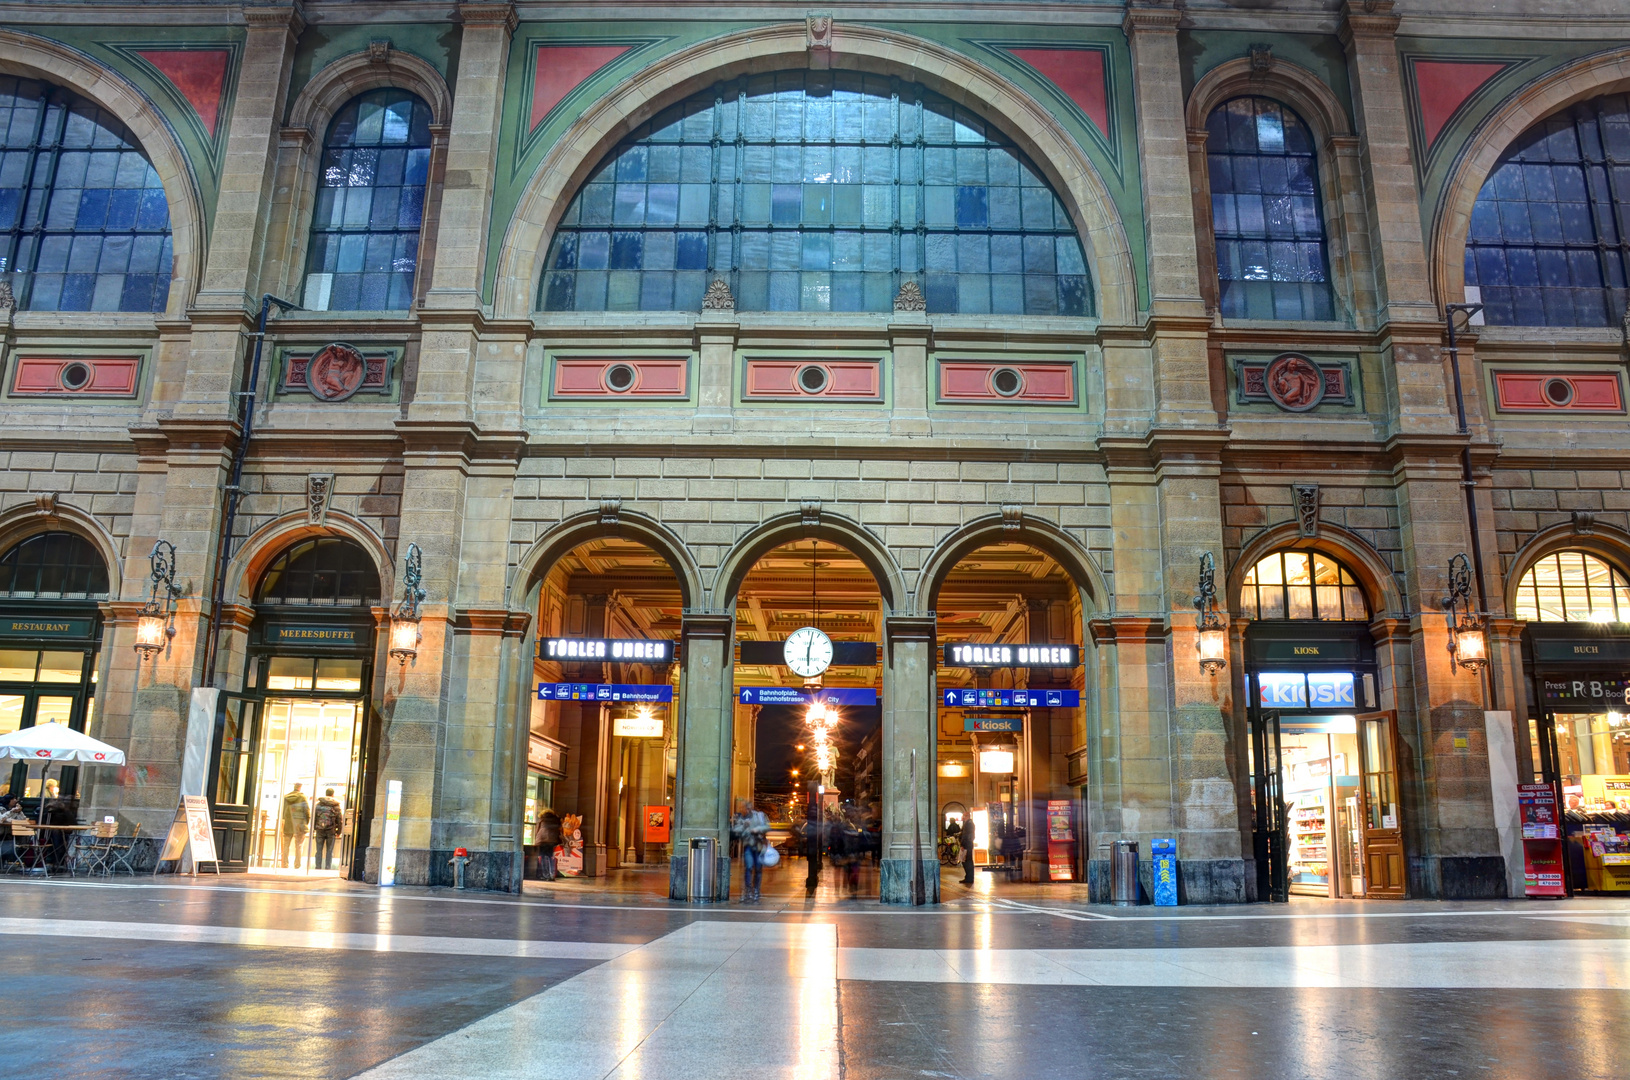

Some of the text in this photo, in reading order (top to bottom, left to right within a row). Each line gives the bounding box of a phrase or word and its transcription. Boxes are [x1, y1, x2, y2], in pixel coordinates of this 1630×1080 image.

[11, 622, 70, 631] RESTAURANT
[279, 629, 355, 639] MEERESBUFFET
[547, 639, 665, 658] TÖRLER UHREN
[1293, 646, 1320, 655] KIOSK
[1573, 646, 1599, 654] BUCH
[953, 645, 1070, 663] TÖRLER UHREN
[1545, 681, 1567, 689] Press
[1272, 679, 1353, 703] kiosk
[981, 721, 1012, 729] kiosk
